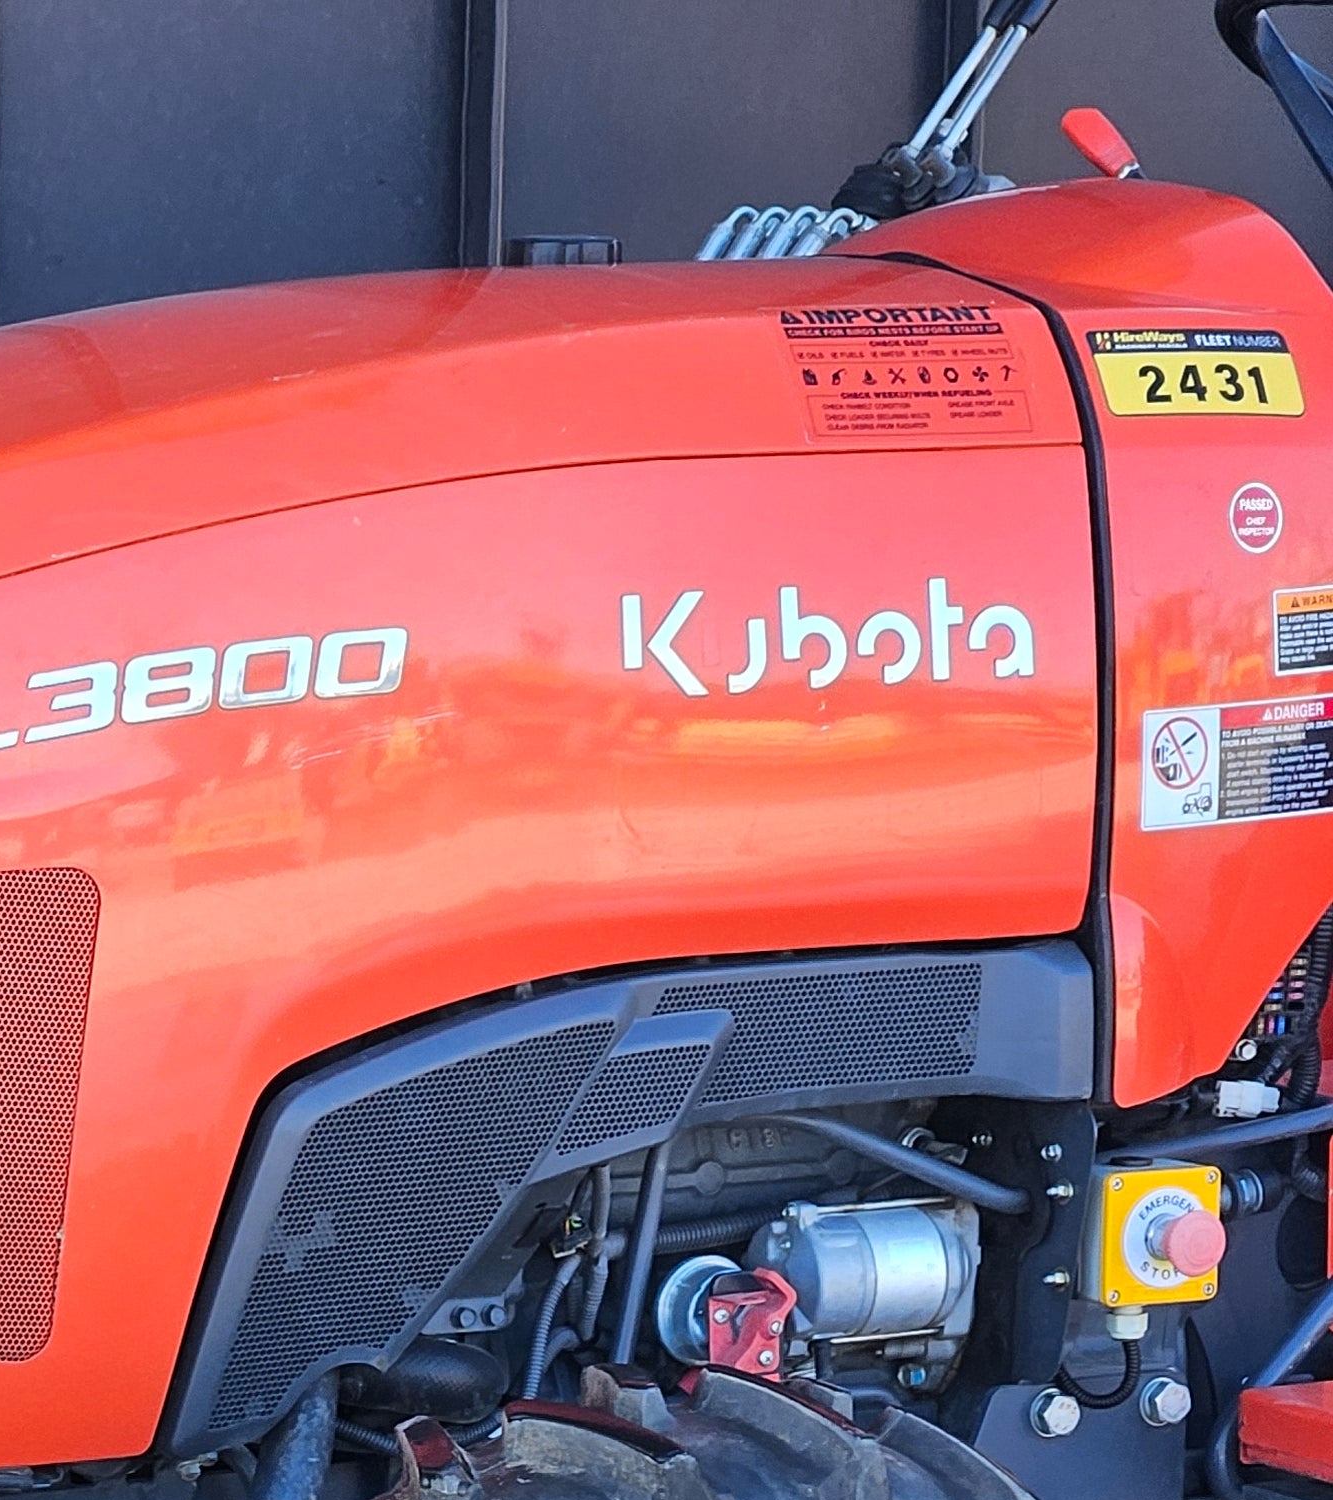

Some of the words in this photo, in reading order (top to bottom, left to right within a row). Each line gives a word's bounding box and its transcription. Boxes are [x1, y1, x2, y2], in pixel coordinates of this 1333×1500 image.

[801, 306, 992, 324] IMPORTANT
[1114, 331, 1186, 343] HireWays
[1194, 335, 1232, 346] FLEET
[1232, 336, 1282, 347] NUMBER
[1139, 364, 1269, 404] 2431
[1239, 498, 1274, 511] PASSED
[1274, 701, 1325, 720] DANGER
[1138, 1194, 1196, 1221] EMERGEN
